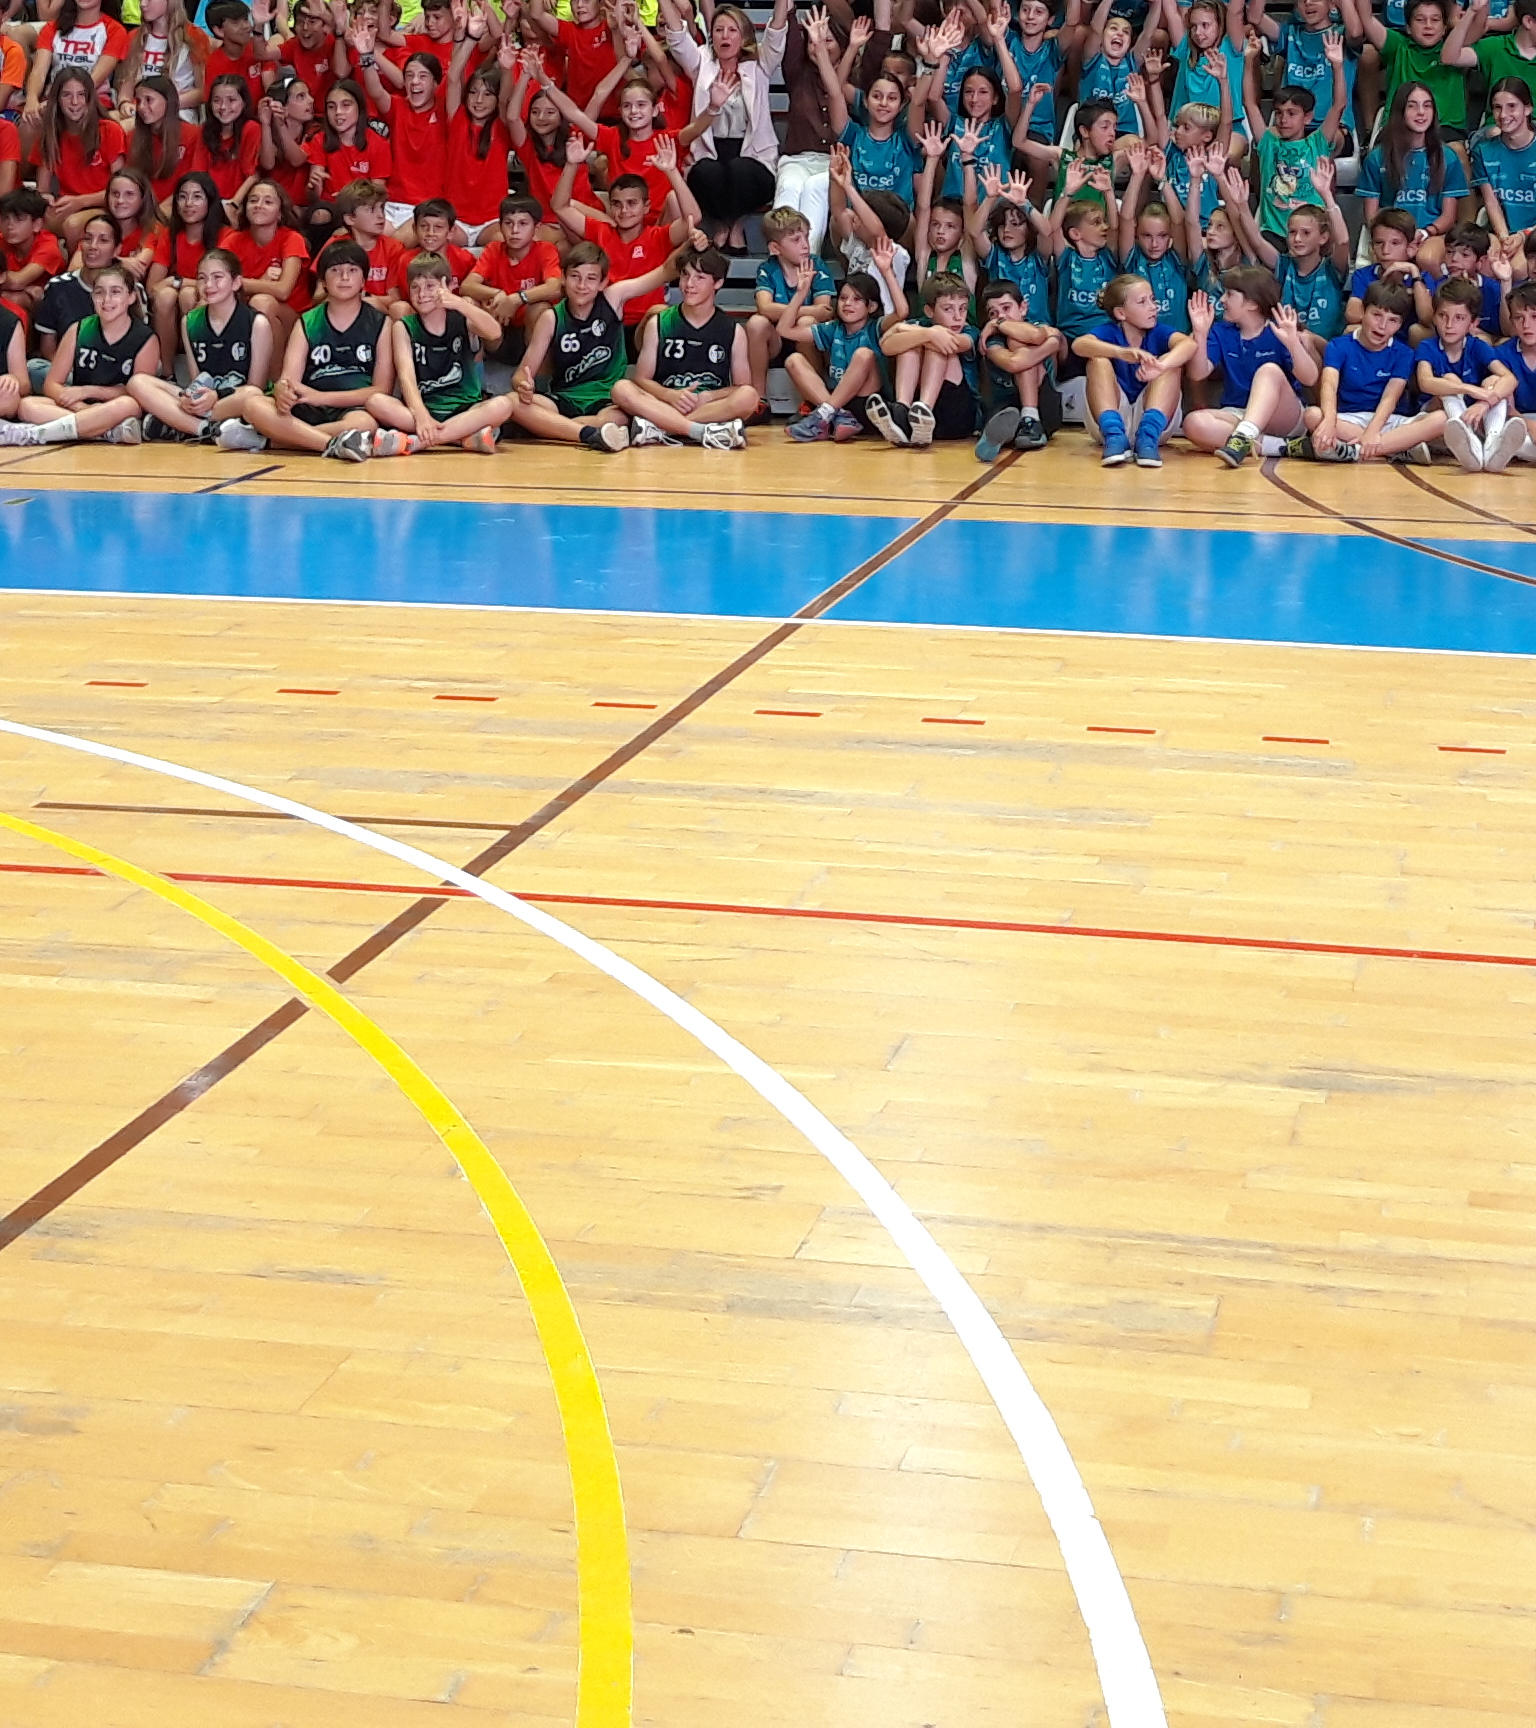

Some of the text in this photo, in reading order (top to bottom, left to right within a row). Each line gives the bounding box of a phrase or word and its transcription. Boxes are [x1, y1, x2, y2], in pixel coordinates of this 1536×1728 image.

[60, 38, 96, 55] TRI
[79, 348, 97, 368] 75
[312, 345, 331, 364] 40
[664, 339, 684, 358] 73
